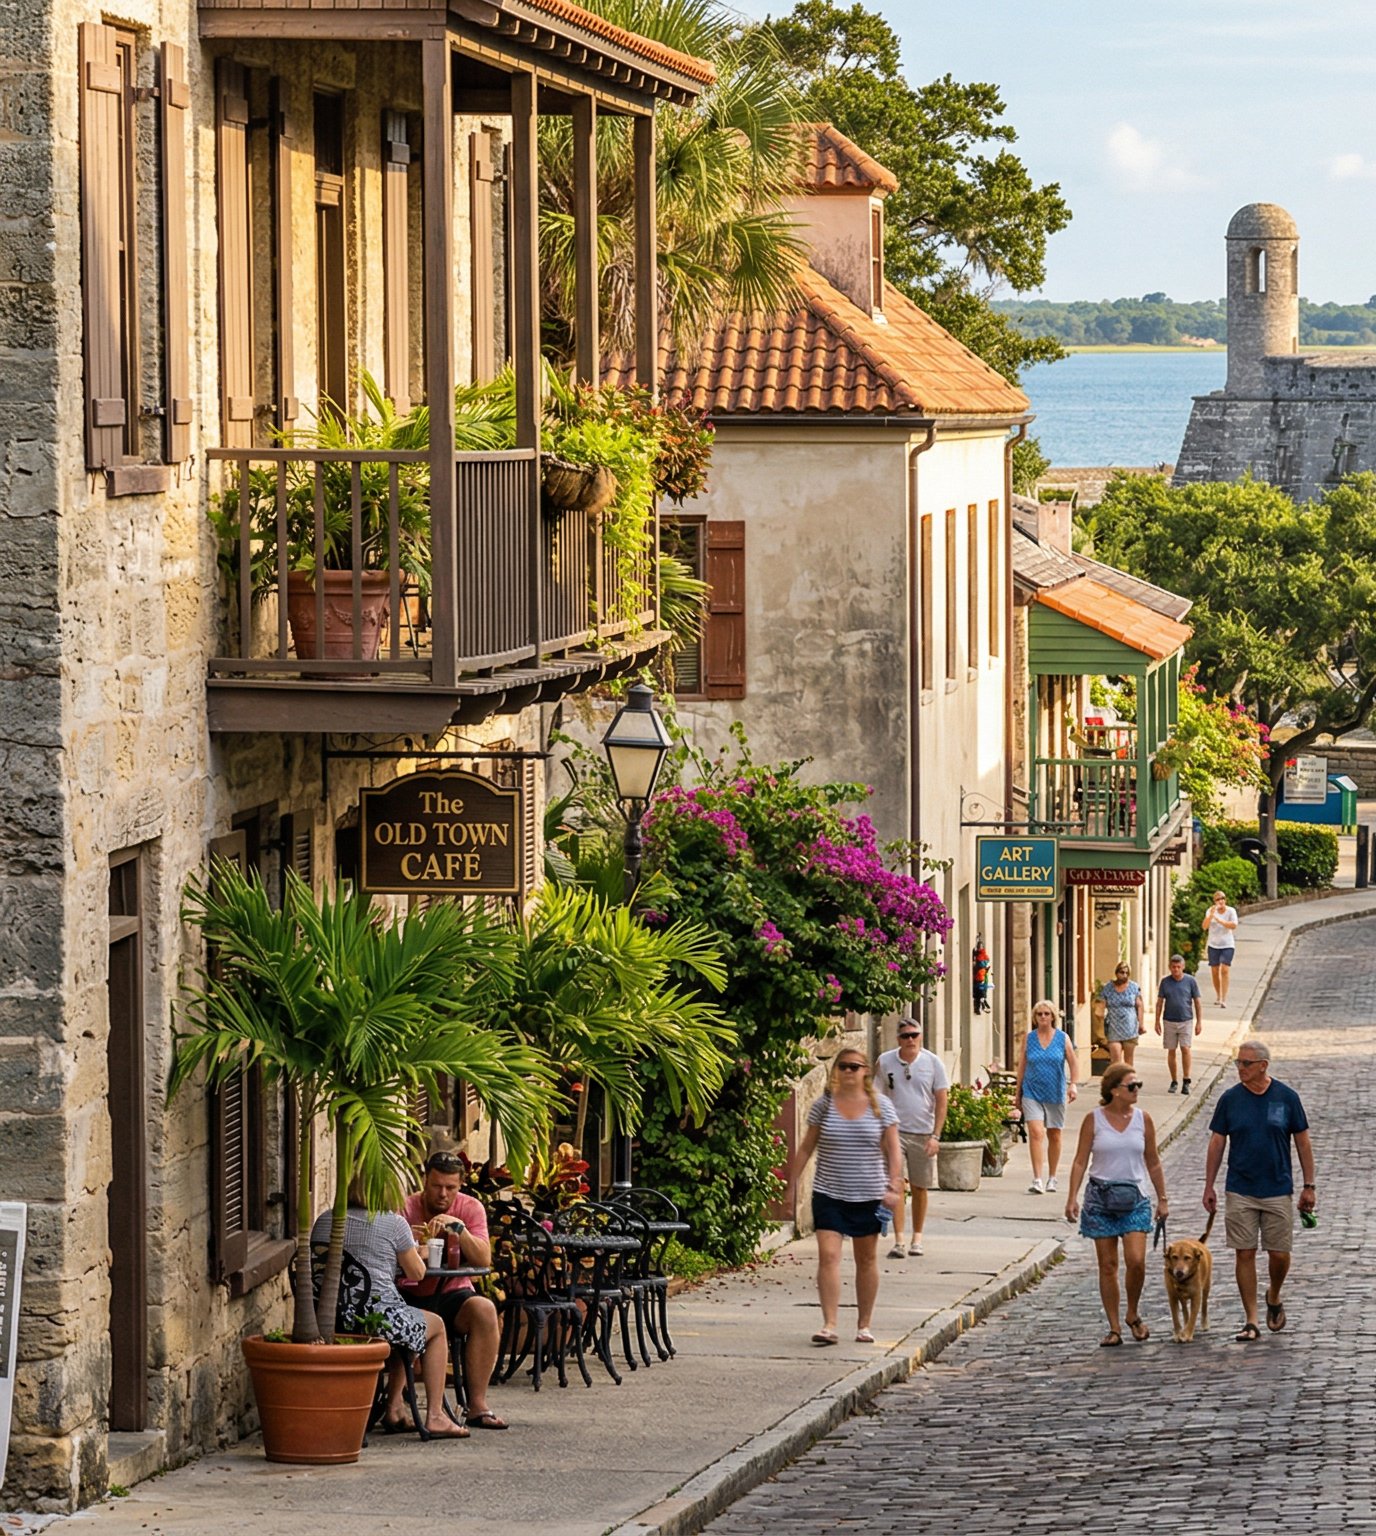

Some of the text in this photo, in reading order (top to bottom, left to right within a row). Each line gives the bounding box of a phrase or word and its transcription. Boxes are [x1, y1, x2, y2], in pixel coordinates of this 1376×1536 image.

[418, 791, 464, 814] The
[374, 822, 509, 847] OLD TOWN
[400, 846, 482, 881] CAFÉ
[999, 846, 1034, 862] ART
[981, 866, 1052, 881] GALLERY
